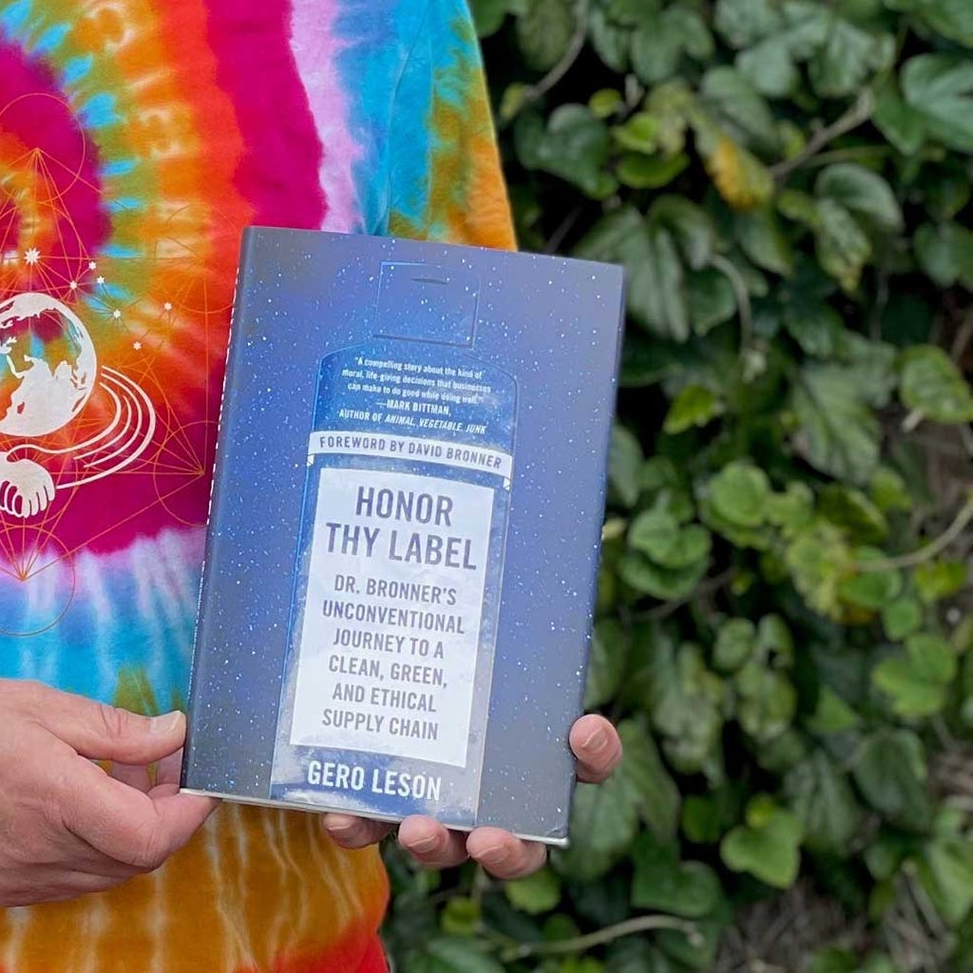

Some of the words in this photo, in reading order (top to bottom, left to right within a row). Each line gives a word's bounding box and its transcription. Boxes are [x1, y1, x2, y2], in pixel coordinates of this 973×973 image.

[342, 369, 364, 379] moral,
[365, 370, 402, 384] life-giving
[402, 376, 436, 387] decisions
[436, 379, 451, 388] that
[452, 382, 492, 393] businesses
[364, 359, 402, 371] compelling
[404, 362, 421, 373] story
[423, 365, 443, 375] about
[444, 367, 456, 376] the
[458, 369, 473, 378] kind
[475, 371, 483, 379] of
[348, 382, 360, 391] can
[362, 384, 381, 393] make
[383, 386, 391, 394] to
[392, 386, 401, 395] do
[402, 388, 420, 399] good
[421, 390, 439, 400] while
[441, 393, 461, 404] doing
[339, 409, 370, 421] AUTHOR
[372, 413, 382, 422] OF
[385, 413, 416, 426] ANIMAL,
[465, 423, 488, 435] JUNK
[412, 401, 452, 417] BITTMAN,
[320, 436, 385, 451] FOREWORD
[390, 439, 405, 452] BY
[408, 442, 443, 458] DAVID
[446, 446, 502, 469] BRONNER
[355, 485, 454, 527] HONOR
[326, 522, 381, 558] THY
[388, 530, 477, 571] LABEL
[334, 574, 360, 594] DR.
[322, 599, 465, 635] UNCONVENTIONAL
[333, 628, 406, 654] JOURNEY
[410, 638, 429, 657] TO
[433, 641, 444, 659] A
[328, 654, 384, 681] CLEAN,
[390, 662, 448, 689] GREEN,
[332, 682, 365, 703] AND
[370, 687, 437, 713] ETHICAL
[322, 708, 385, 734] SUPPLY
[388, 717, 439, 741] CHAIN
[307, 760, 365, 791] GERO
[371, 768, 442, 802] LESON
